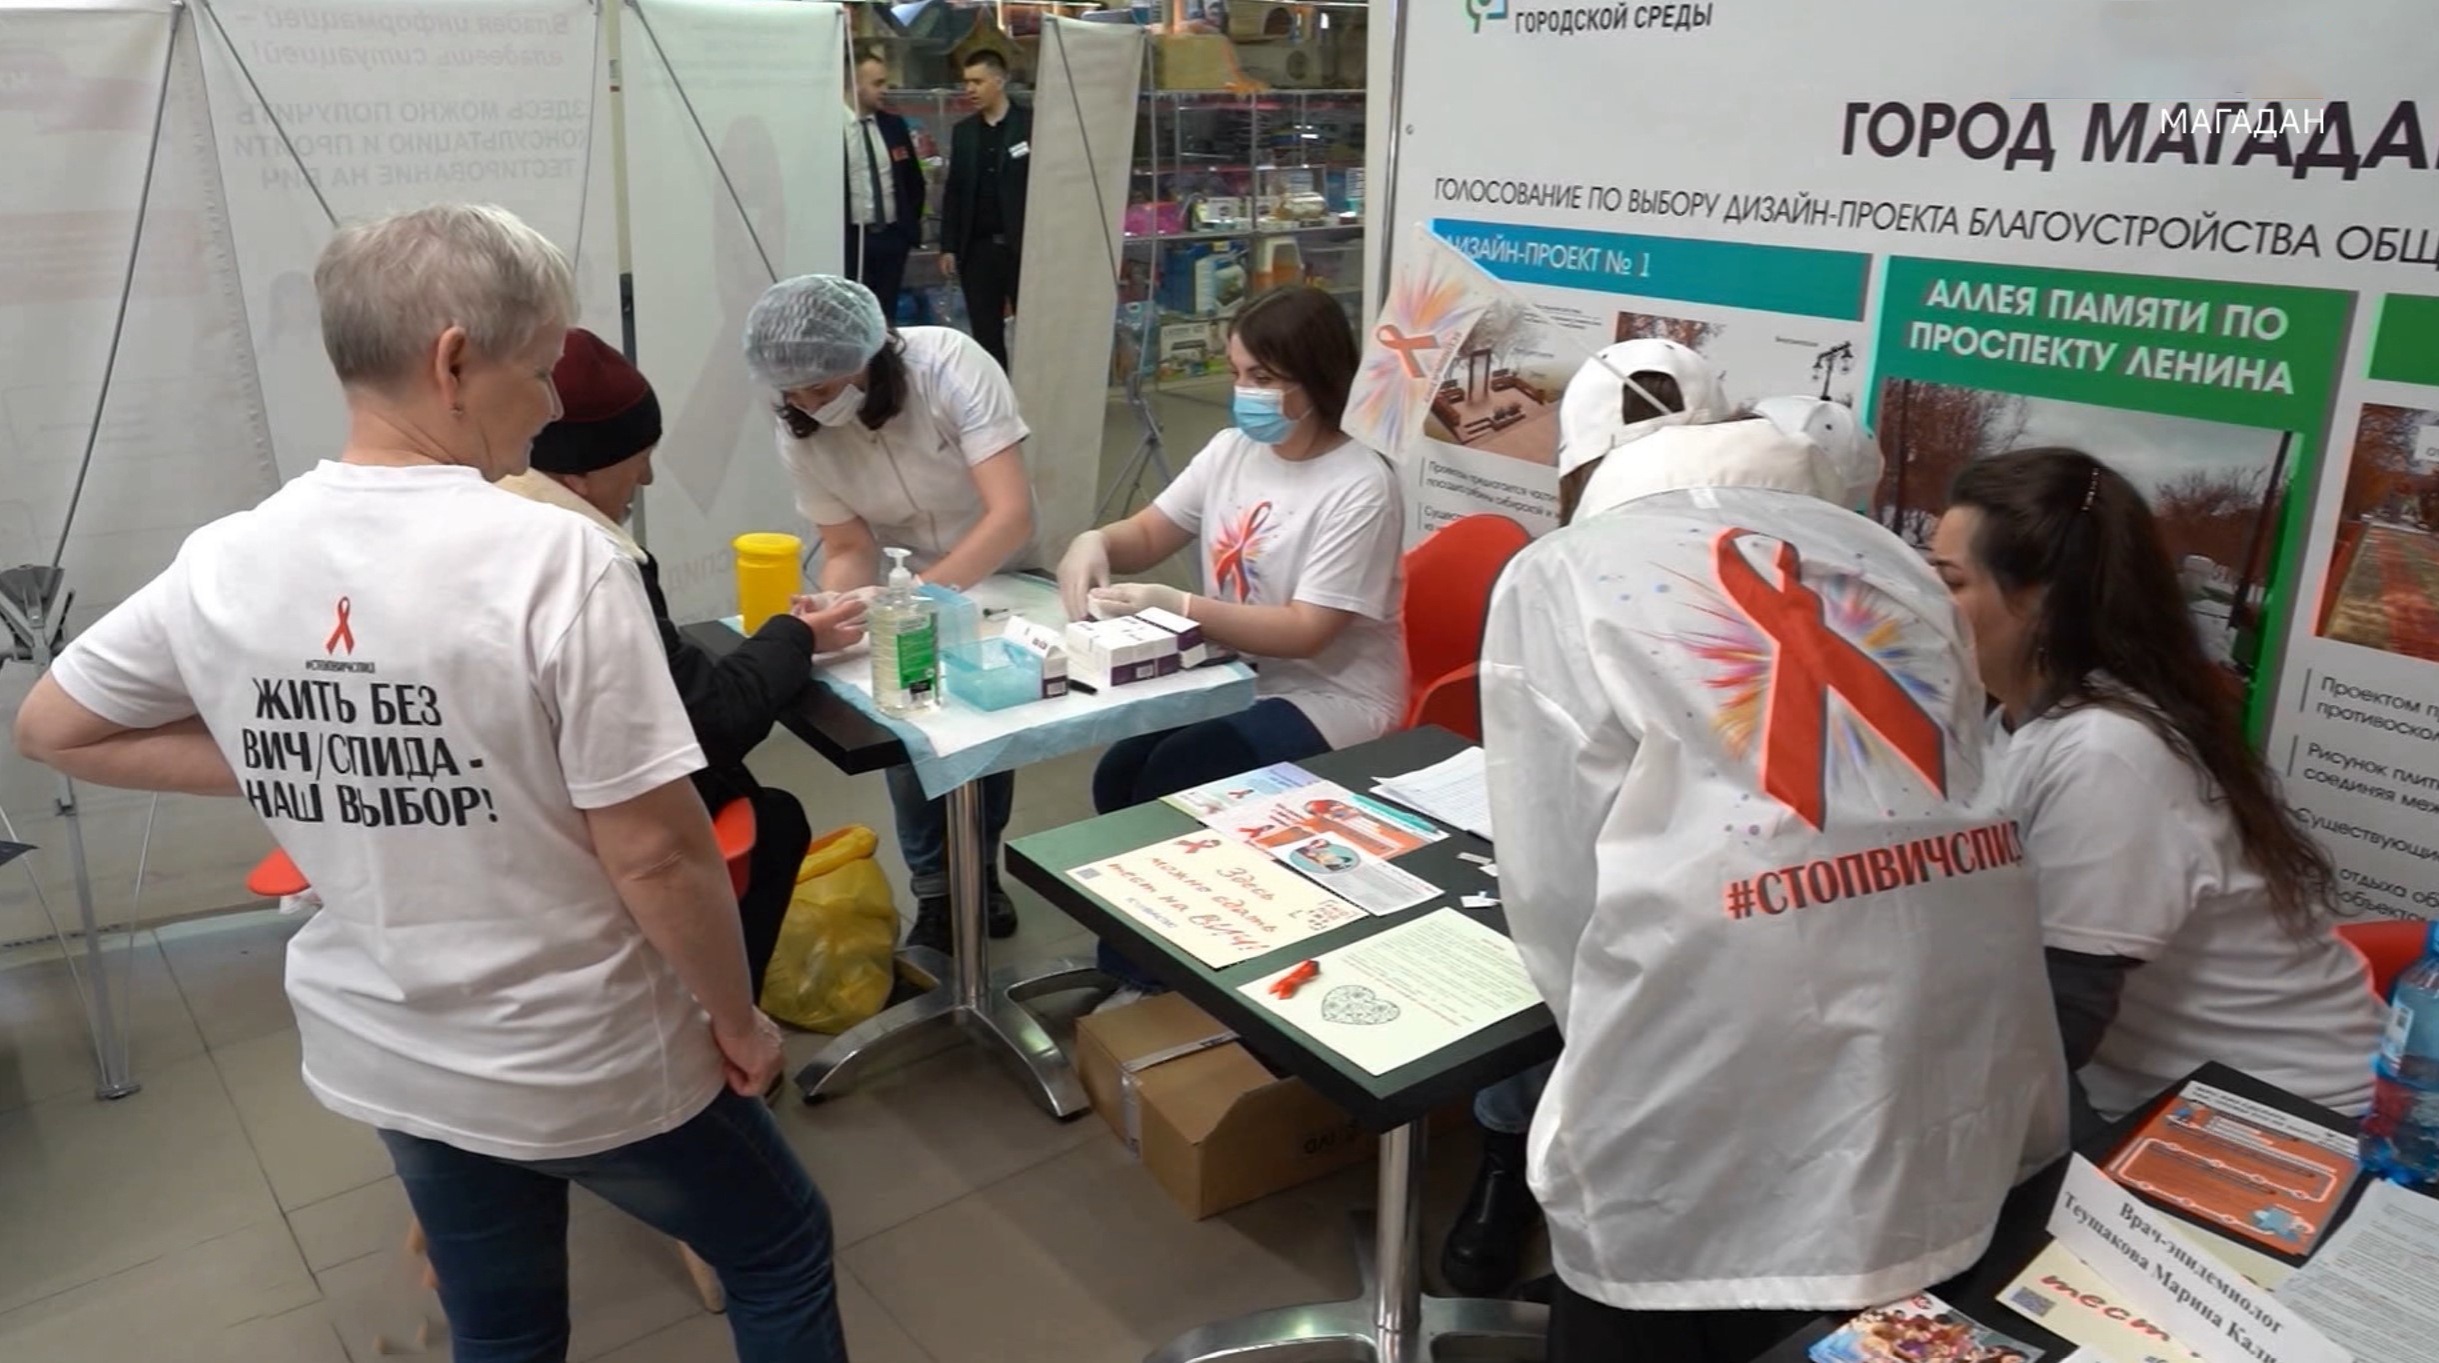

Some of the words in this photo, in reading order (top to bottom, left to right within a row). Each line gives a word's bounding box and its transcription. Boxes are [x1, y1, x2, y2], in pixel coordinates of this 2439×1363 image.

[1515, 3, 1628, 35] ГОРОДСКОЙ
[1634, 2, 1713, 32] СРЕДЫ
[1842, 100, 2056, 172] ГОРОД
[2080, 100, 2439, 181] МАГАДА
[1435, 177, 1583, 209] ГОЛОСОВАНИЕ
[1587, 186, 1622, 212] ПО
[1628, 188, 1721, 220] ВЫБОРУ
[1724, 191, 1959, 236] ДИЗАЙН-ПРОЕКТА
[1968, 205, 2322, 258] БЛАГОУСТРОЙСТВА
[1604, 251, 1633, 276] №
[1639, 253, 1651, 278] 1
[1926, 279, 2040, 317] АЛЛЕЯ
[2048, 287, 2212, 333] ПАМЯТИ
[2221, 303, 2291, 343] ПО
[1909, 320, 2118, 375] ПРОСПЕКТУ
[2125, 347, 2296, 396] ЛЕНИНА
[252, 677, 357, 724] ЖИТЬ
[370, 683, 442, 726] БЕЗ
[2321, 676, 2421, 713] Проектом
[242, 728, 461, 782] ВИЧ/СПИДА
[2307, 742, 2388, 776] Рисунок
[246, 779, 324, 823] НАШ
[336, 784, 498, 828] ВЫБОР!
[2303, 767, 2396, 802] соединяя
[1150, 857, 1212, 894] можно
[1211, 892, 1278, 934] сдать
[1216, 866, 1277, 902] Здесь
[2338, 867, 2407, 898] отдыха
[2063, 1191, 2150, 1271] Теушакова
[2150, 1263, 2223, 1330] Марина
[2118, 1202, 2286, 1336] Врач-эпидемиолог
